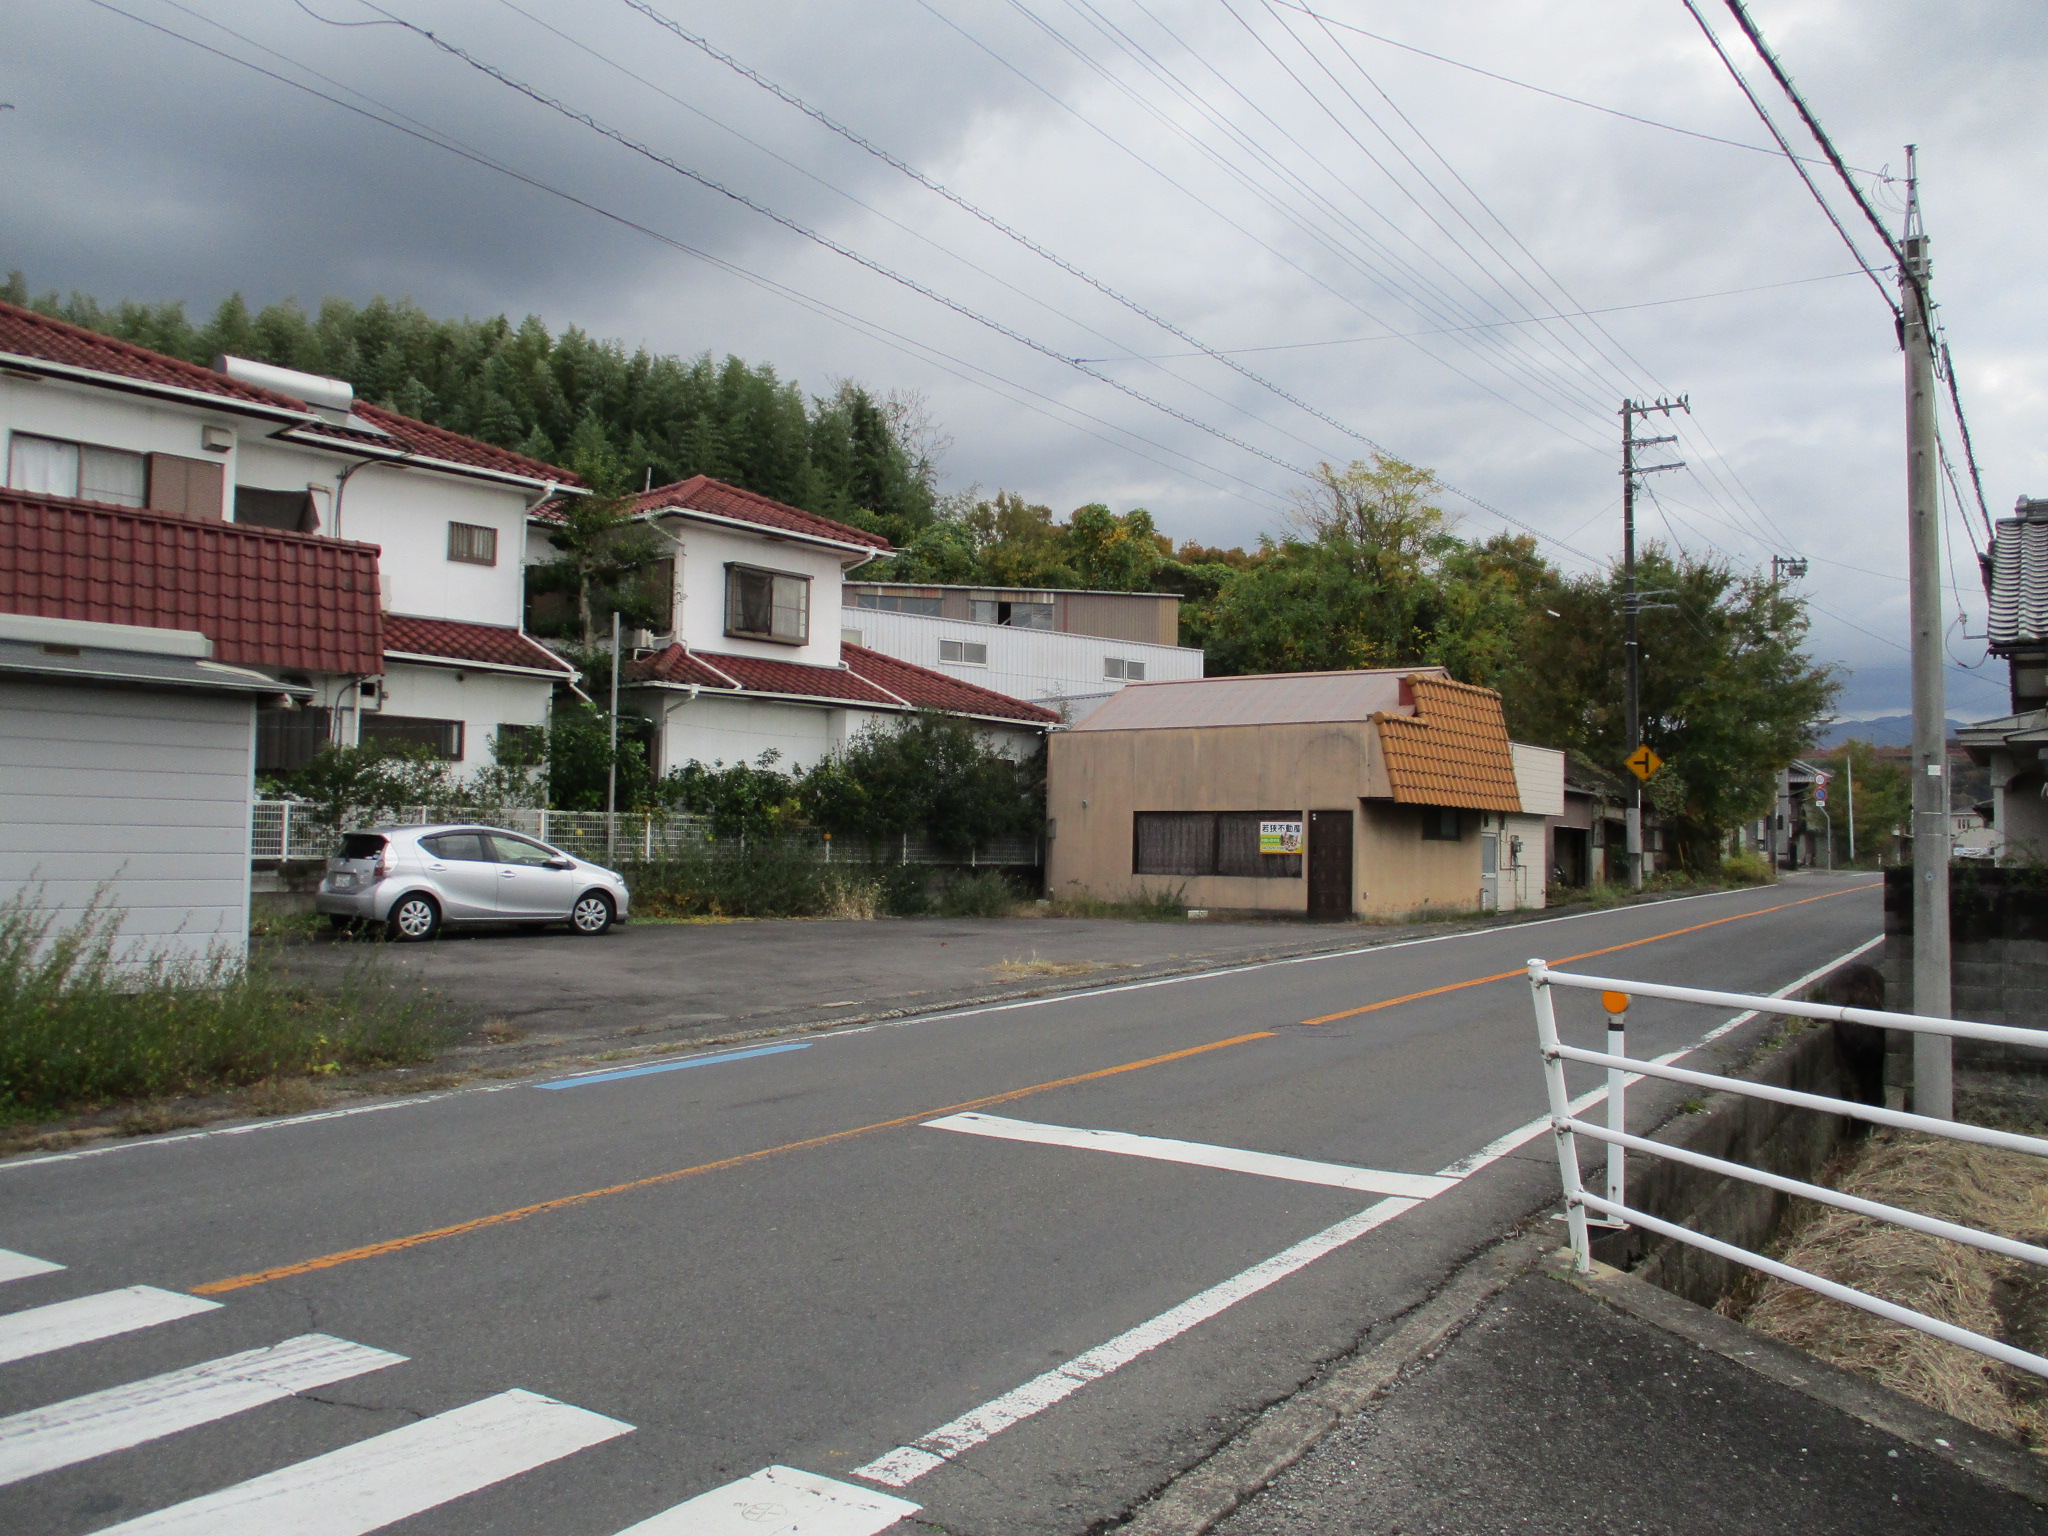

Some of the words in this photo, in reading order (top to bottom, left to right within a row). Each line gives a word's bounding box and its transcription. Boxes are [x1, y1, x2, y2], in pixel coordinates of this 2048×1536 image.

[1262, 824, 1301, 833] 若狭不動産
